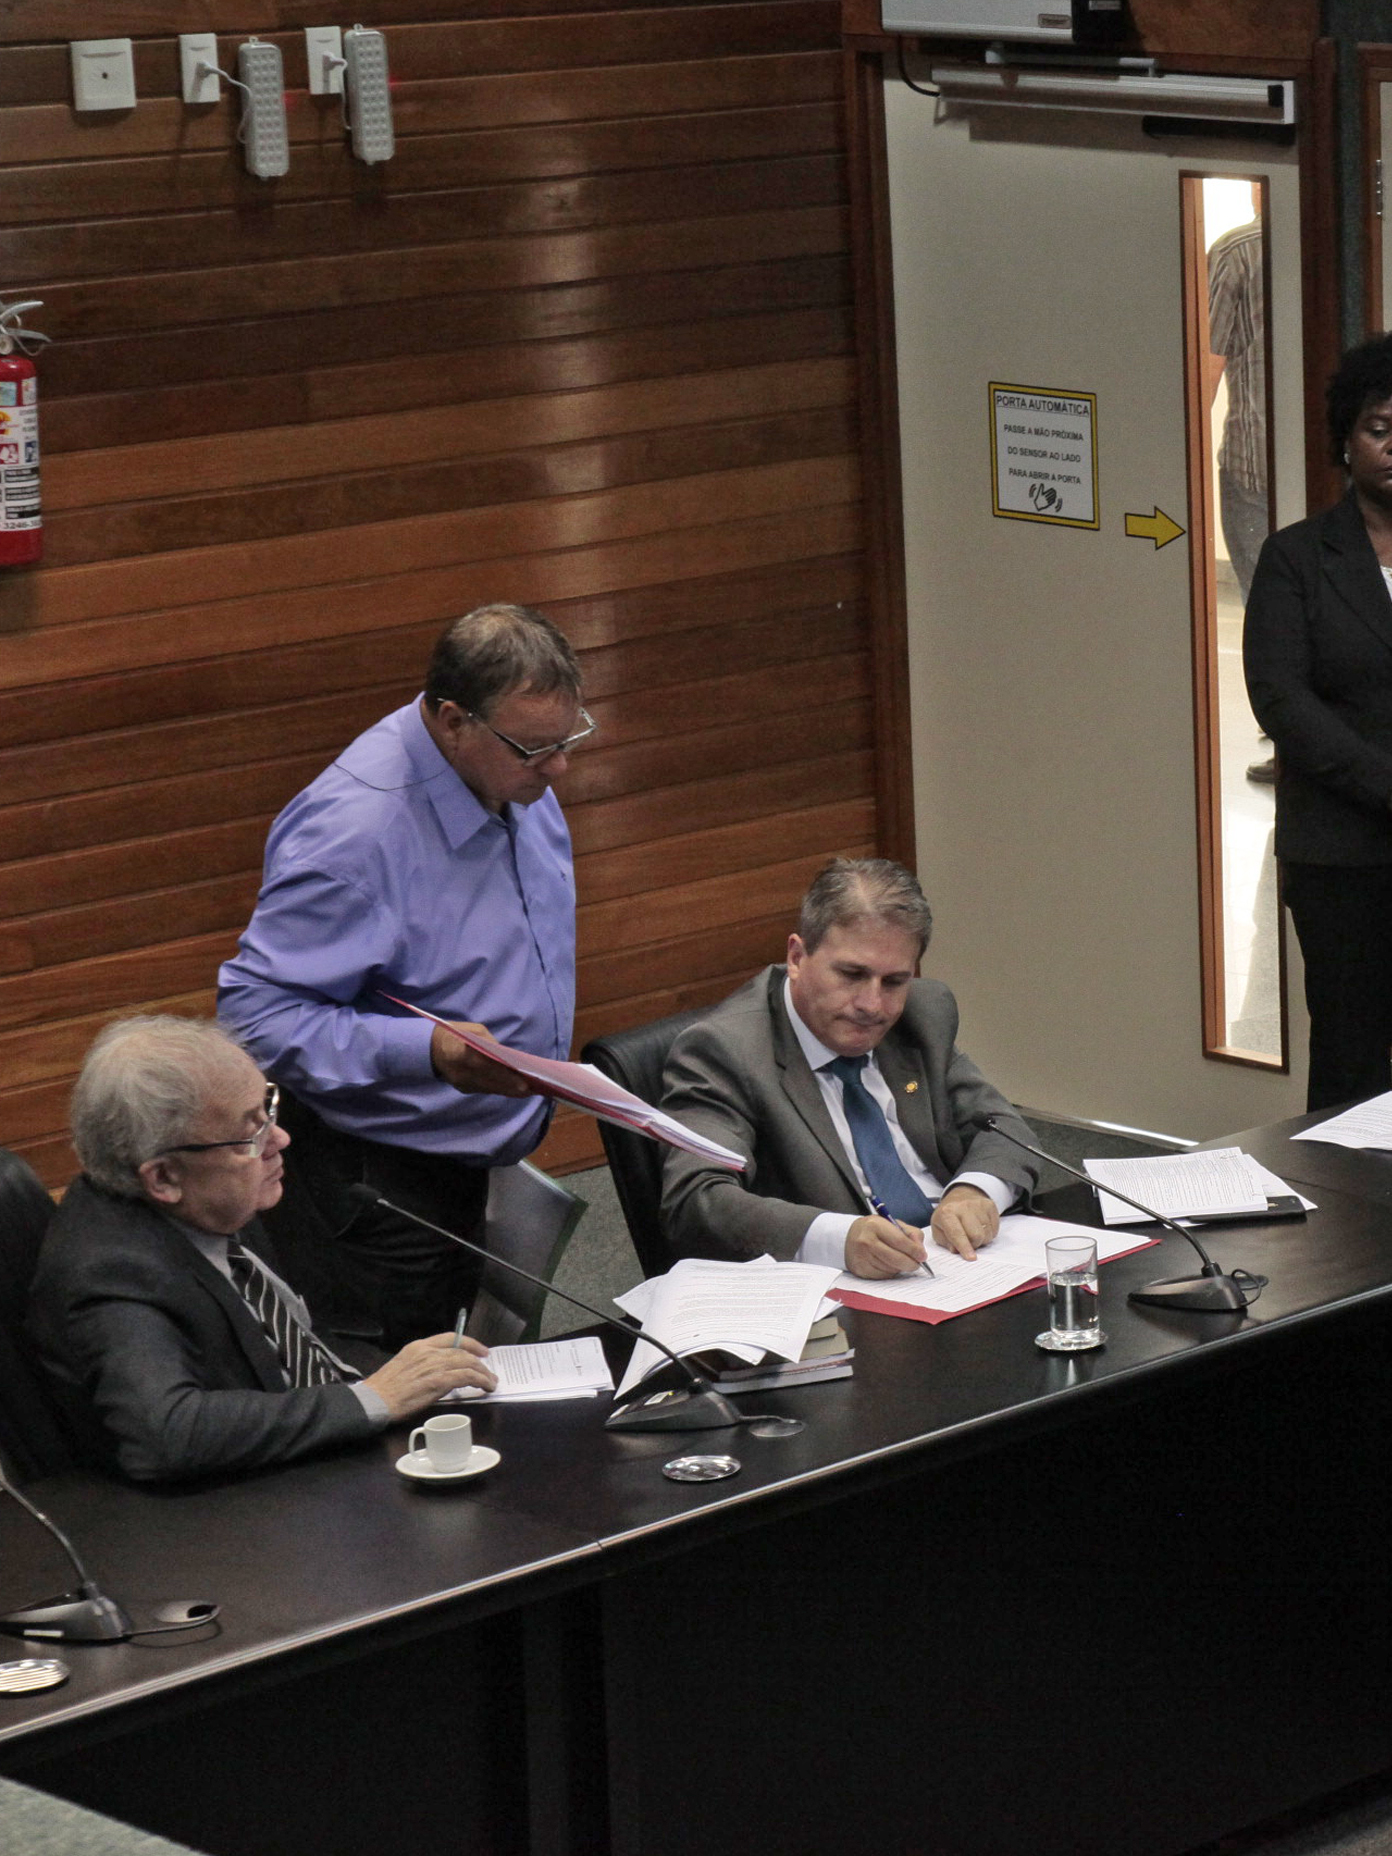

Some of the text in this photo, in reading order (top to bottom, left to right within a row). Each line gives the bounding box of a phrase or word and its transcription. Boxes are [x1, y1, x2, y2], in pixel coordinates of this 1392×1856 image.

[996, 395, 1090, 415] PORTA AUTOMÁTICA
[1003, 424, 1026, 435] PASSE
[1034, 427, 1050, 437] MÃO
[1051, 430, 1084, 441] PRÓXIMA
[1007, 446, 1081, 462] DO SENSOR AO LADO
[1008, 467, 1028, 477] PARA
[1028, 471, 1050, 480] ABRIR
[1057, 474, 1082, 484] PORTA
